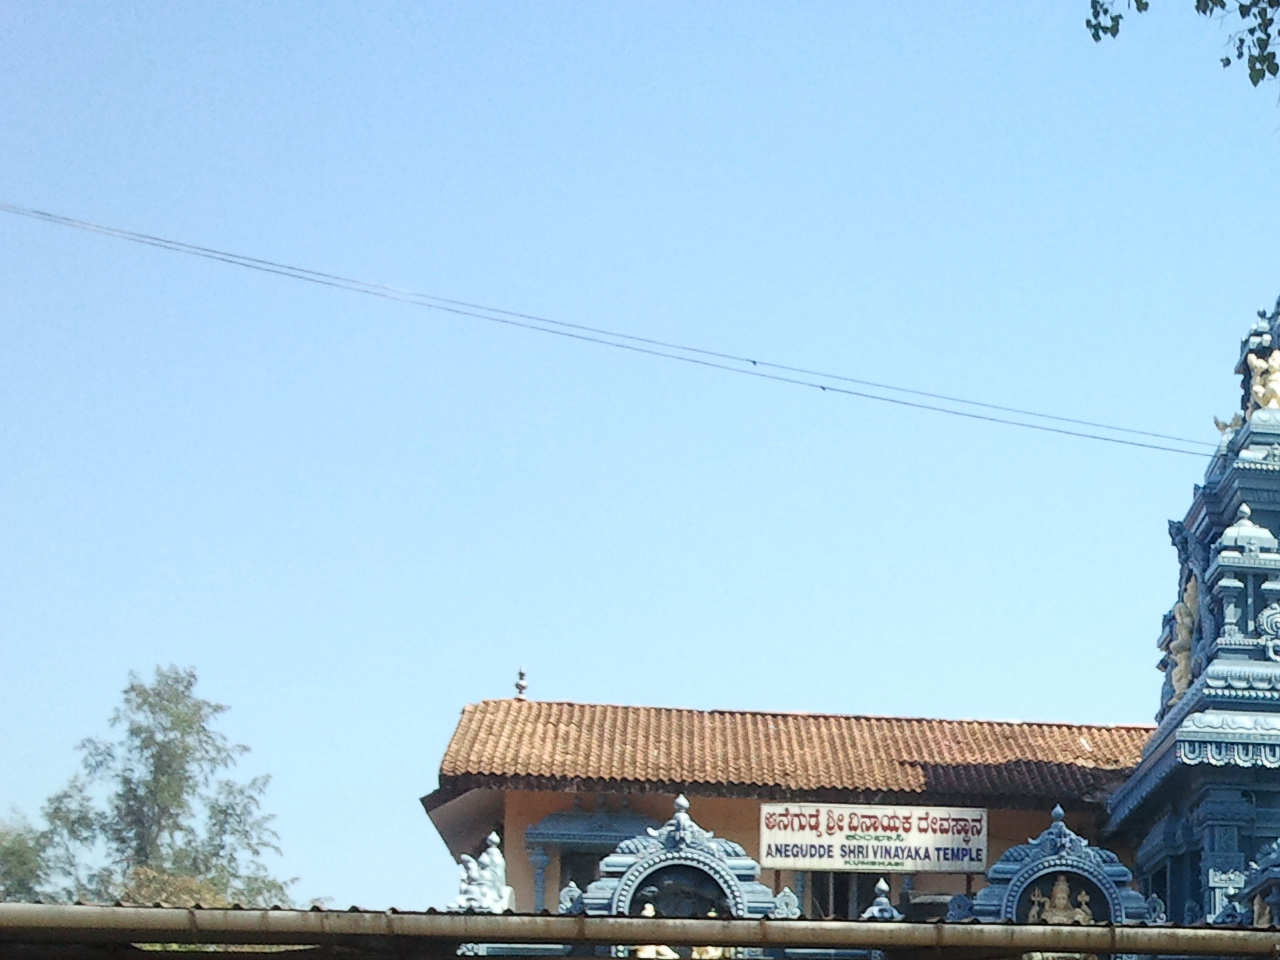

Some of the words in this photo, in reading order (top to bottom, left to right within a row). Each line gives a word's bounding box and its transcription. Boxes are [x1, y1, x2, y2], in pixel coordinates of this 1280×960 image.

[825, 809, 844, 836] ಶ್ರೀ
[847, 810, 912, 834] ವಿನಾಯಕ
[917, 811, 983, 845] ದೇವಸ್ಥಾನ
[765, 843, 834, 859] ANEGUDDE
[840, 844, 868, 859] SHRI
[871, 845, 931, 861] VINAYAKA
[935, 847, 983, 862] TEMPLE
